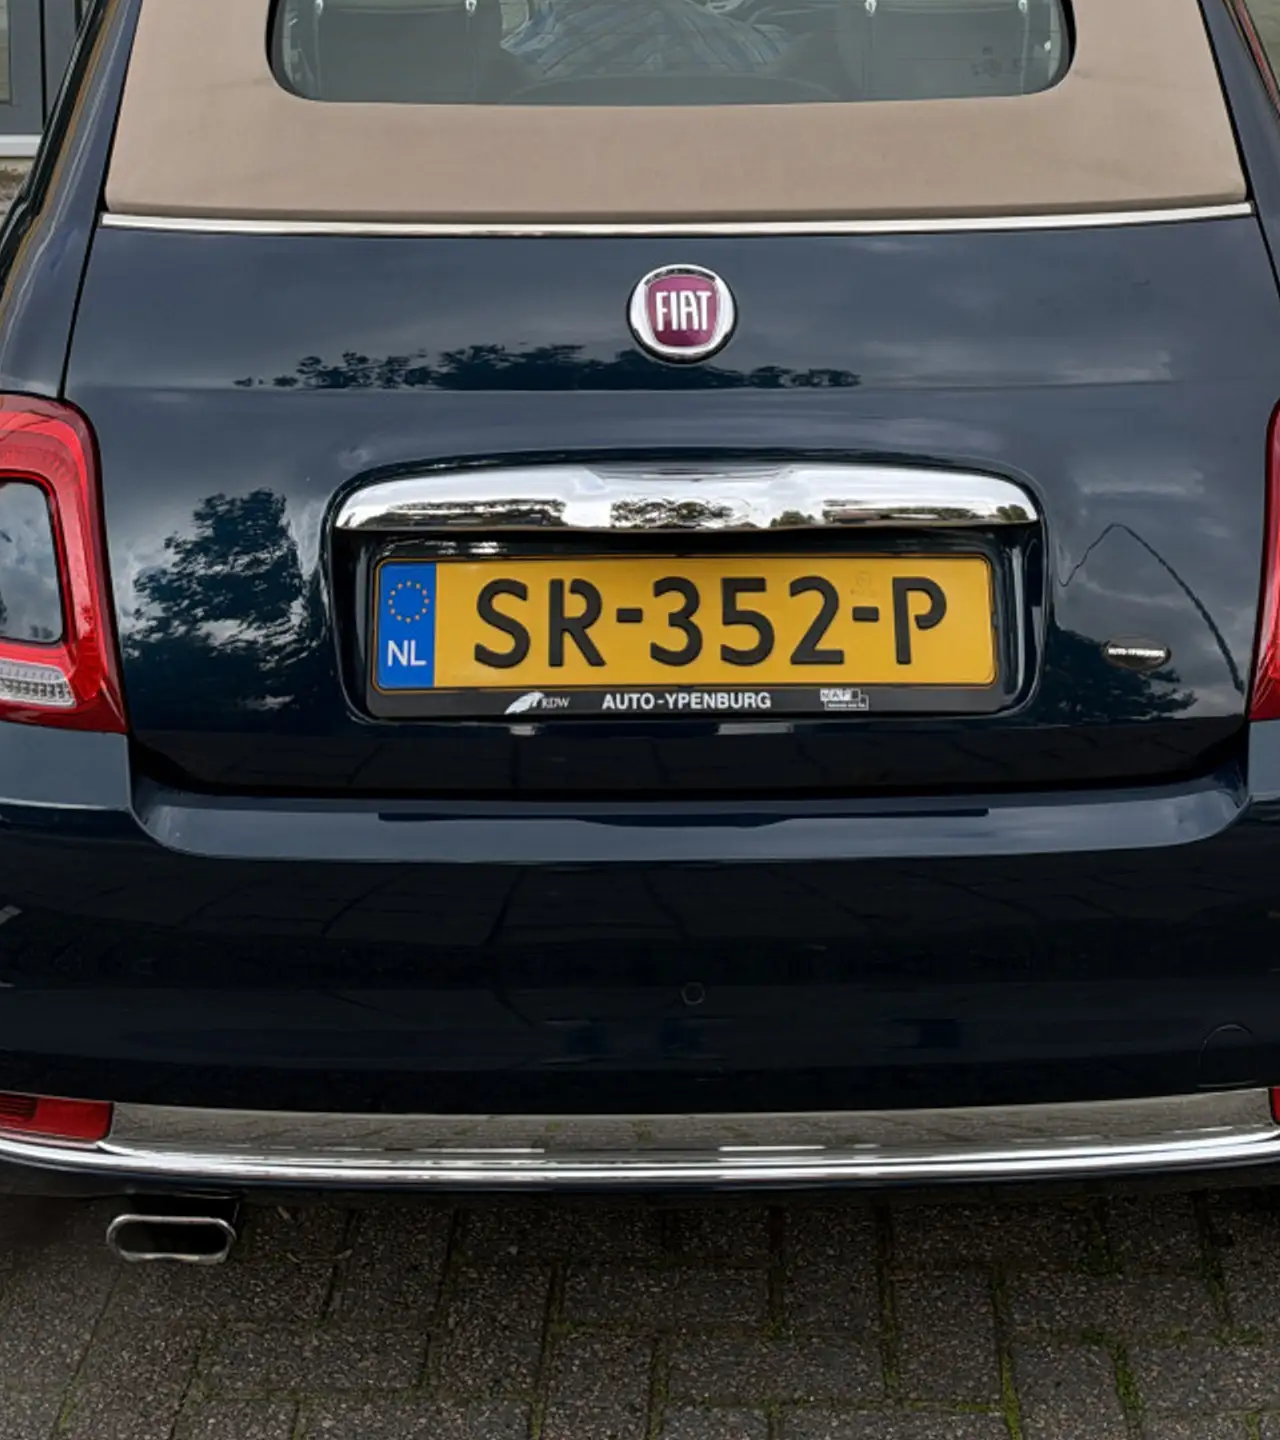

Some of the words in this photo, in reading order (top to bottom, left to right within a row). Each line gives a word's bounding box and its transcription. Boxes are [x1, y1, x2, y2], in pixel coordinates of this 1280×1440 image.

[655, 290, 713, 332] FIAT
[473, 575, 948, 669] SR-352-P
[386, 640, 427, 667] NL
[601, 692, 772, 709] AUTO-YPENBURG
